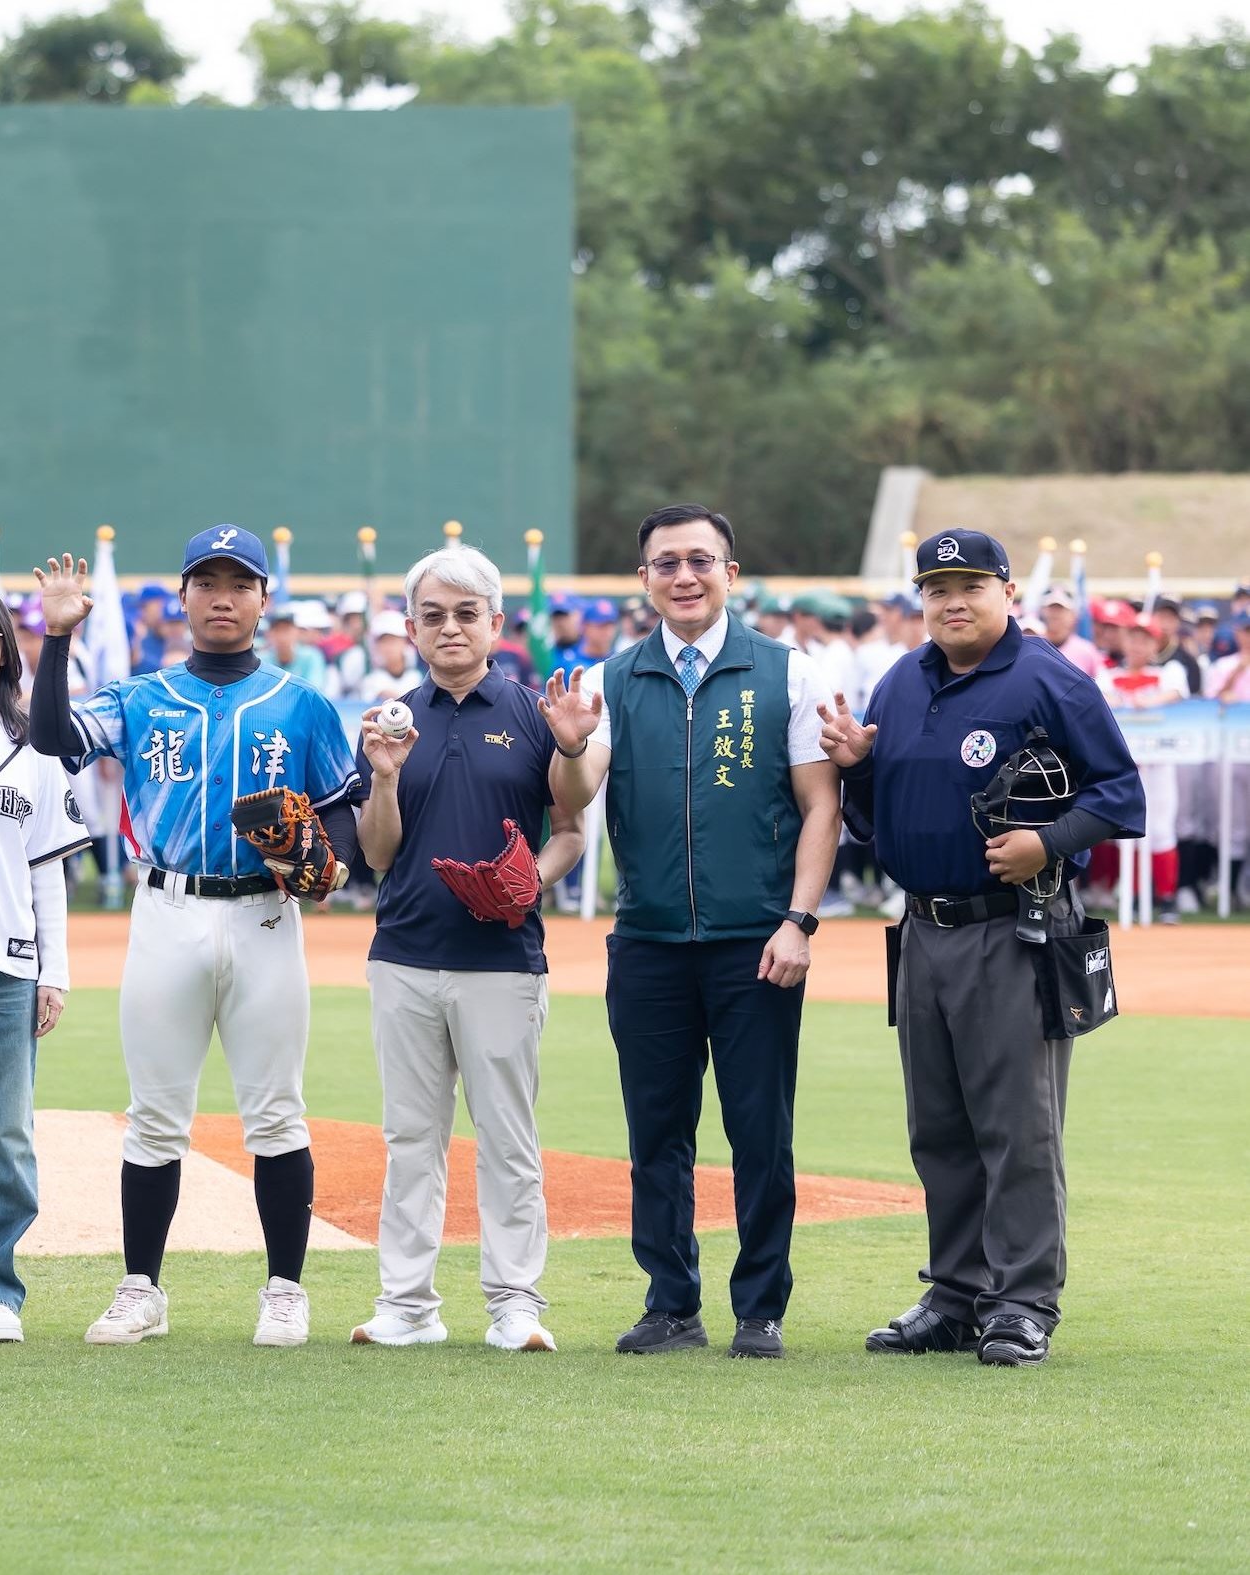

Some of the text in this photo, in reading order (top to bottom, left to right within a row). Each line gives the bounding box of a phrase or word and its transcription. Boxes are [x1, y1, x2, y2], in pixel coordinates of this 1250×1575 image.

[211, 529, 238, 550] L
[937, 545, 954, 555] BFA
[713, 709, 737, 788] 王效文
[740, 689, 755, 769] 體育局局長
